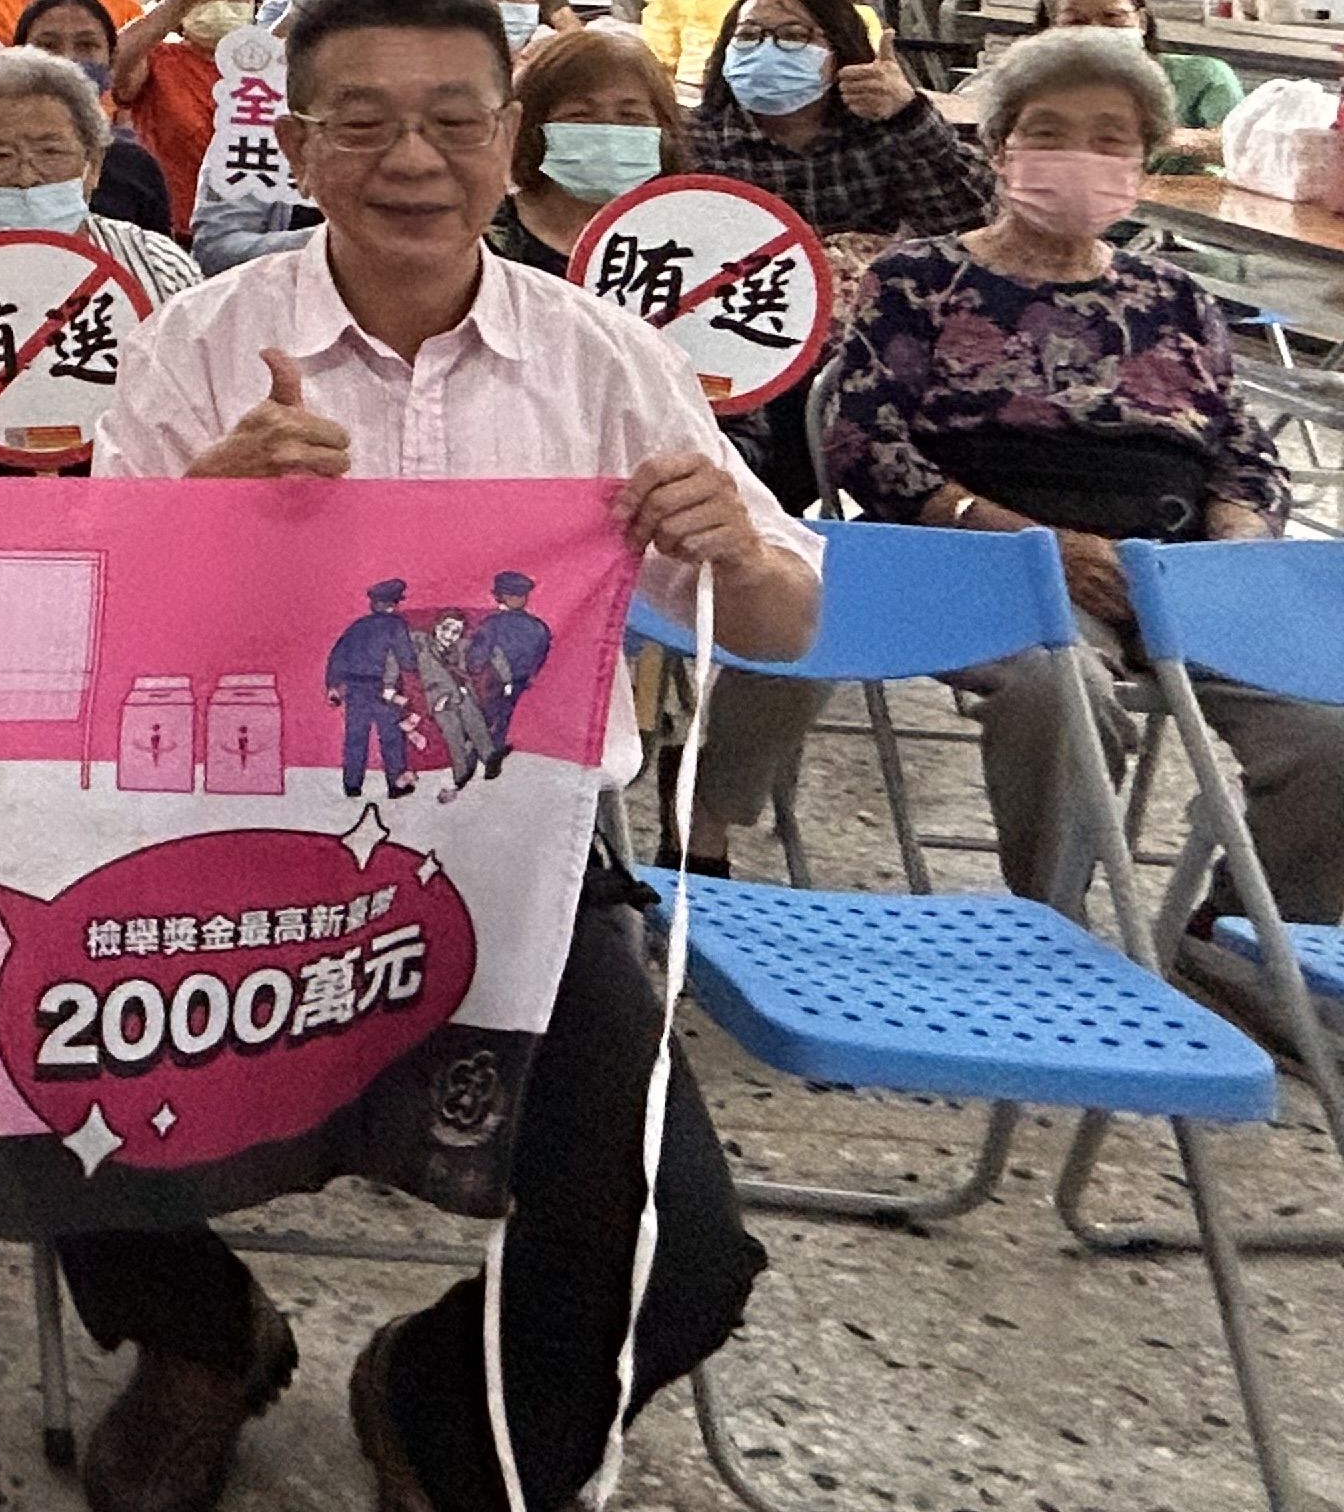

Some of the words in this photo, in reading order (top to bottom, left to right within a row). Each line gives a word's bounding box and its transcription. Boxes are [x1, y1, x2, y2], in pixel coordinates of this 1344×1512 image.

[231, 76, 285, 126] 全
[226, 137, 297, 188] 共
[596, 233, 803, 348] 賄選
[35, 924, 425, 1068] 2000萬元
